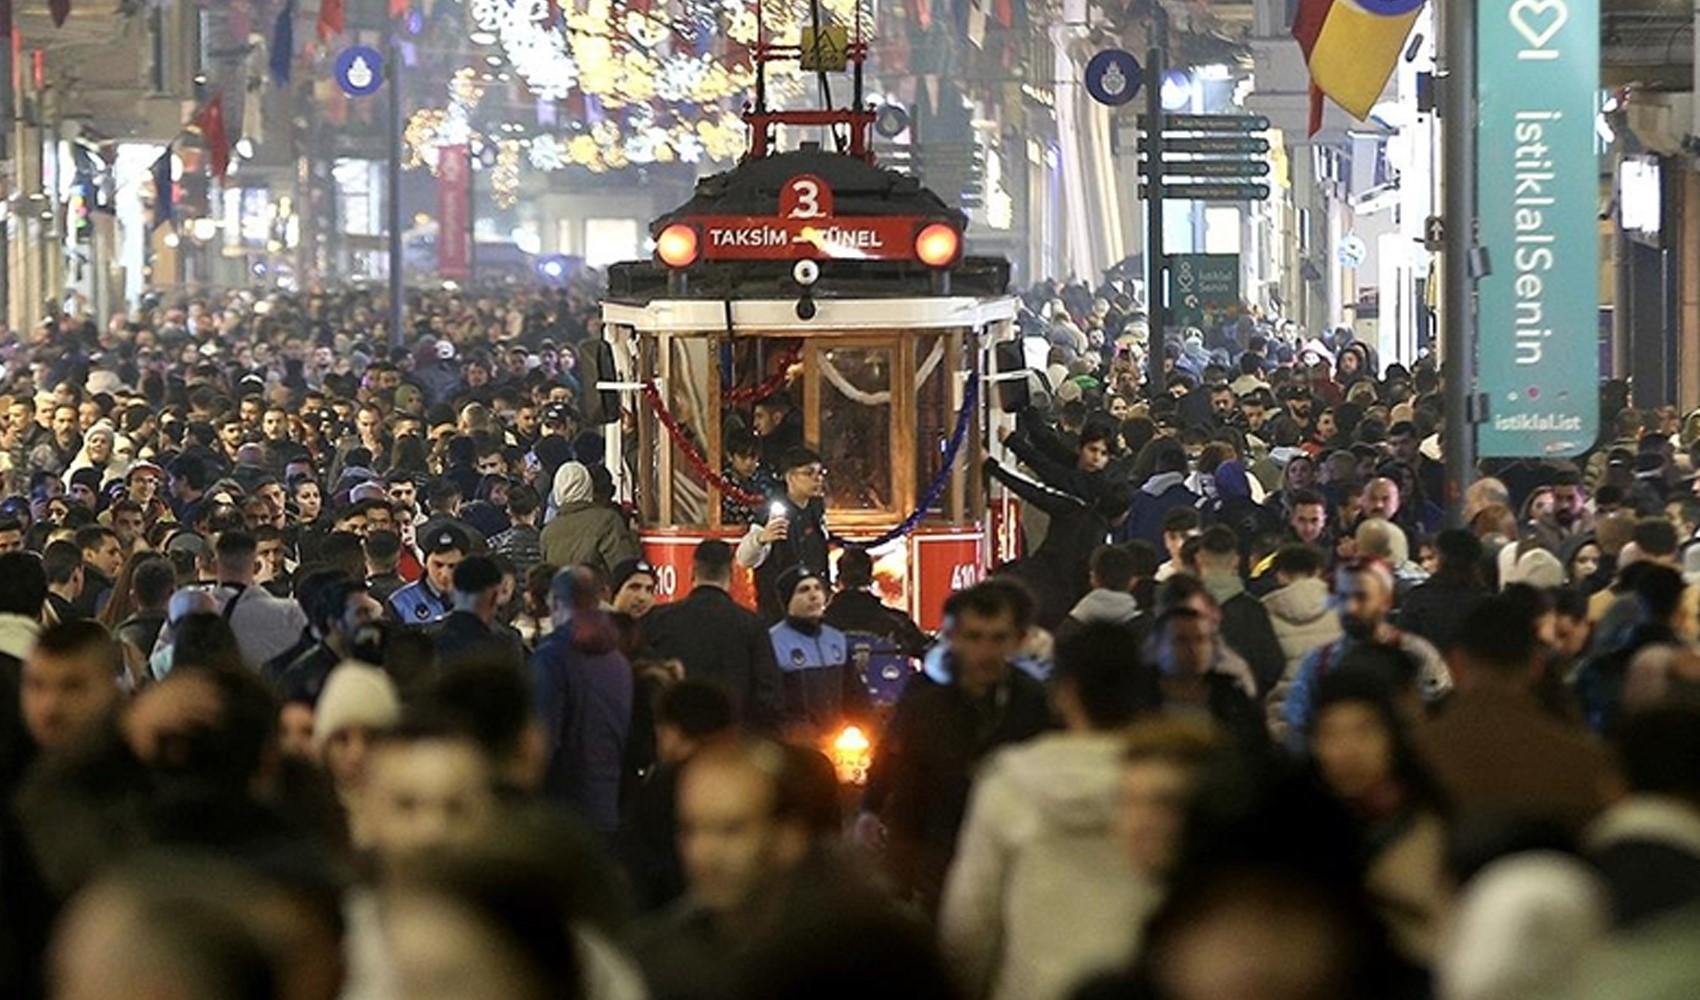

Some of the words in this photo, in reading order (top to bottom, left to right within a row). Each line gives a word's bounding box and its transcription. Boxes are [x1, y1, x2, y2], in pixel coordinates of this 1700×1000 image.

[792, 181, 819, 219] 3
[710, 225, 787, 246] TAKSİM
[817, 226, 883, 247] TÜNEL
